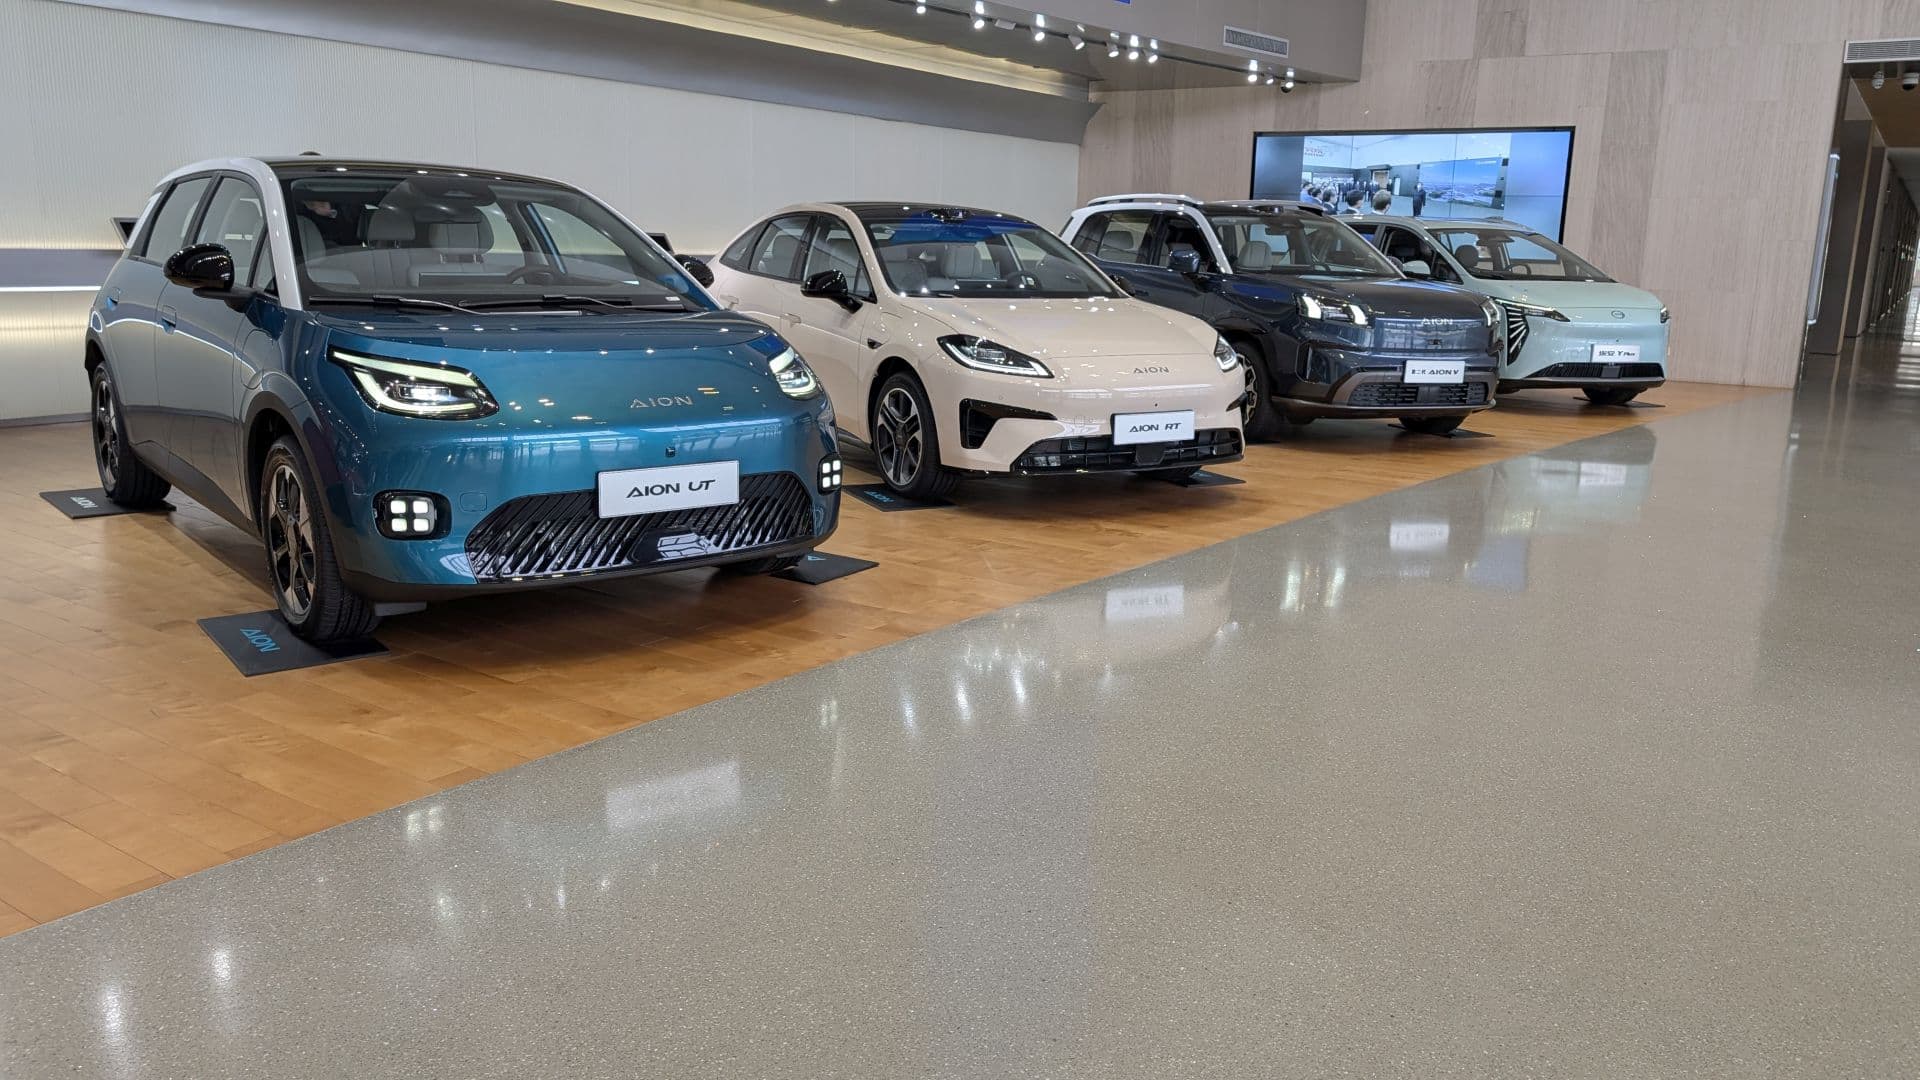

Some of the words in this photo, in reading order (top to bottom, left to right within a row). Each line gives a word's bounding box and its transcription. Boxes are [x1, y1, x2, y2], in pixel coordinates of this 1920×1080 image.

[1421, 317, 1453, 325] AION
[1133, 366, 1170, 374] AION
[630, 395, 693, 409] AION
[1129, 423, 1159, 433] AION
[1164, 422, 1182, 430] RT
[626, 483, 680, 499] AION
[688, 479, 716, 491] UT
[69, 496, 98, 509] AION
[240, 628, 281, 653] AION
